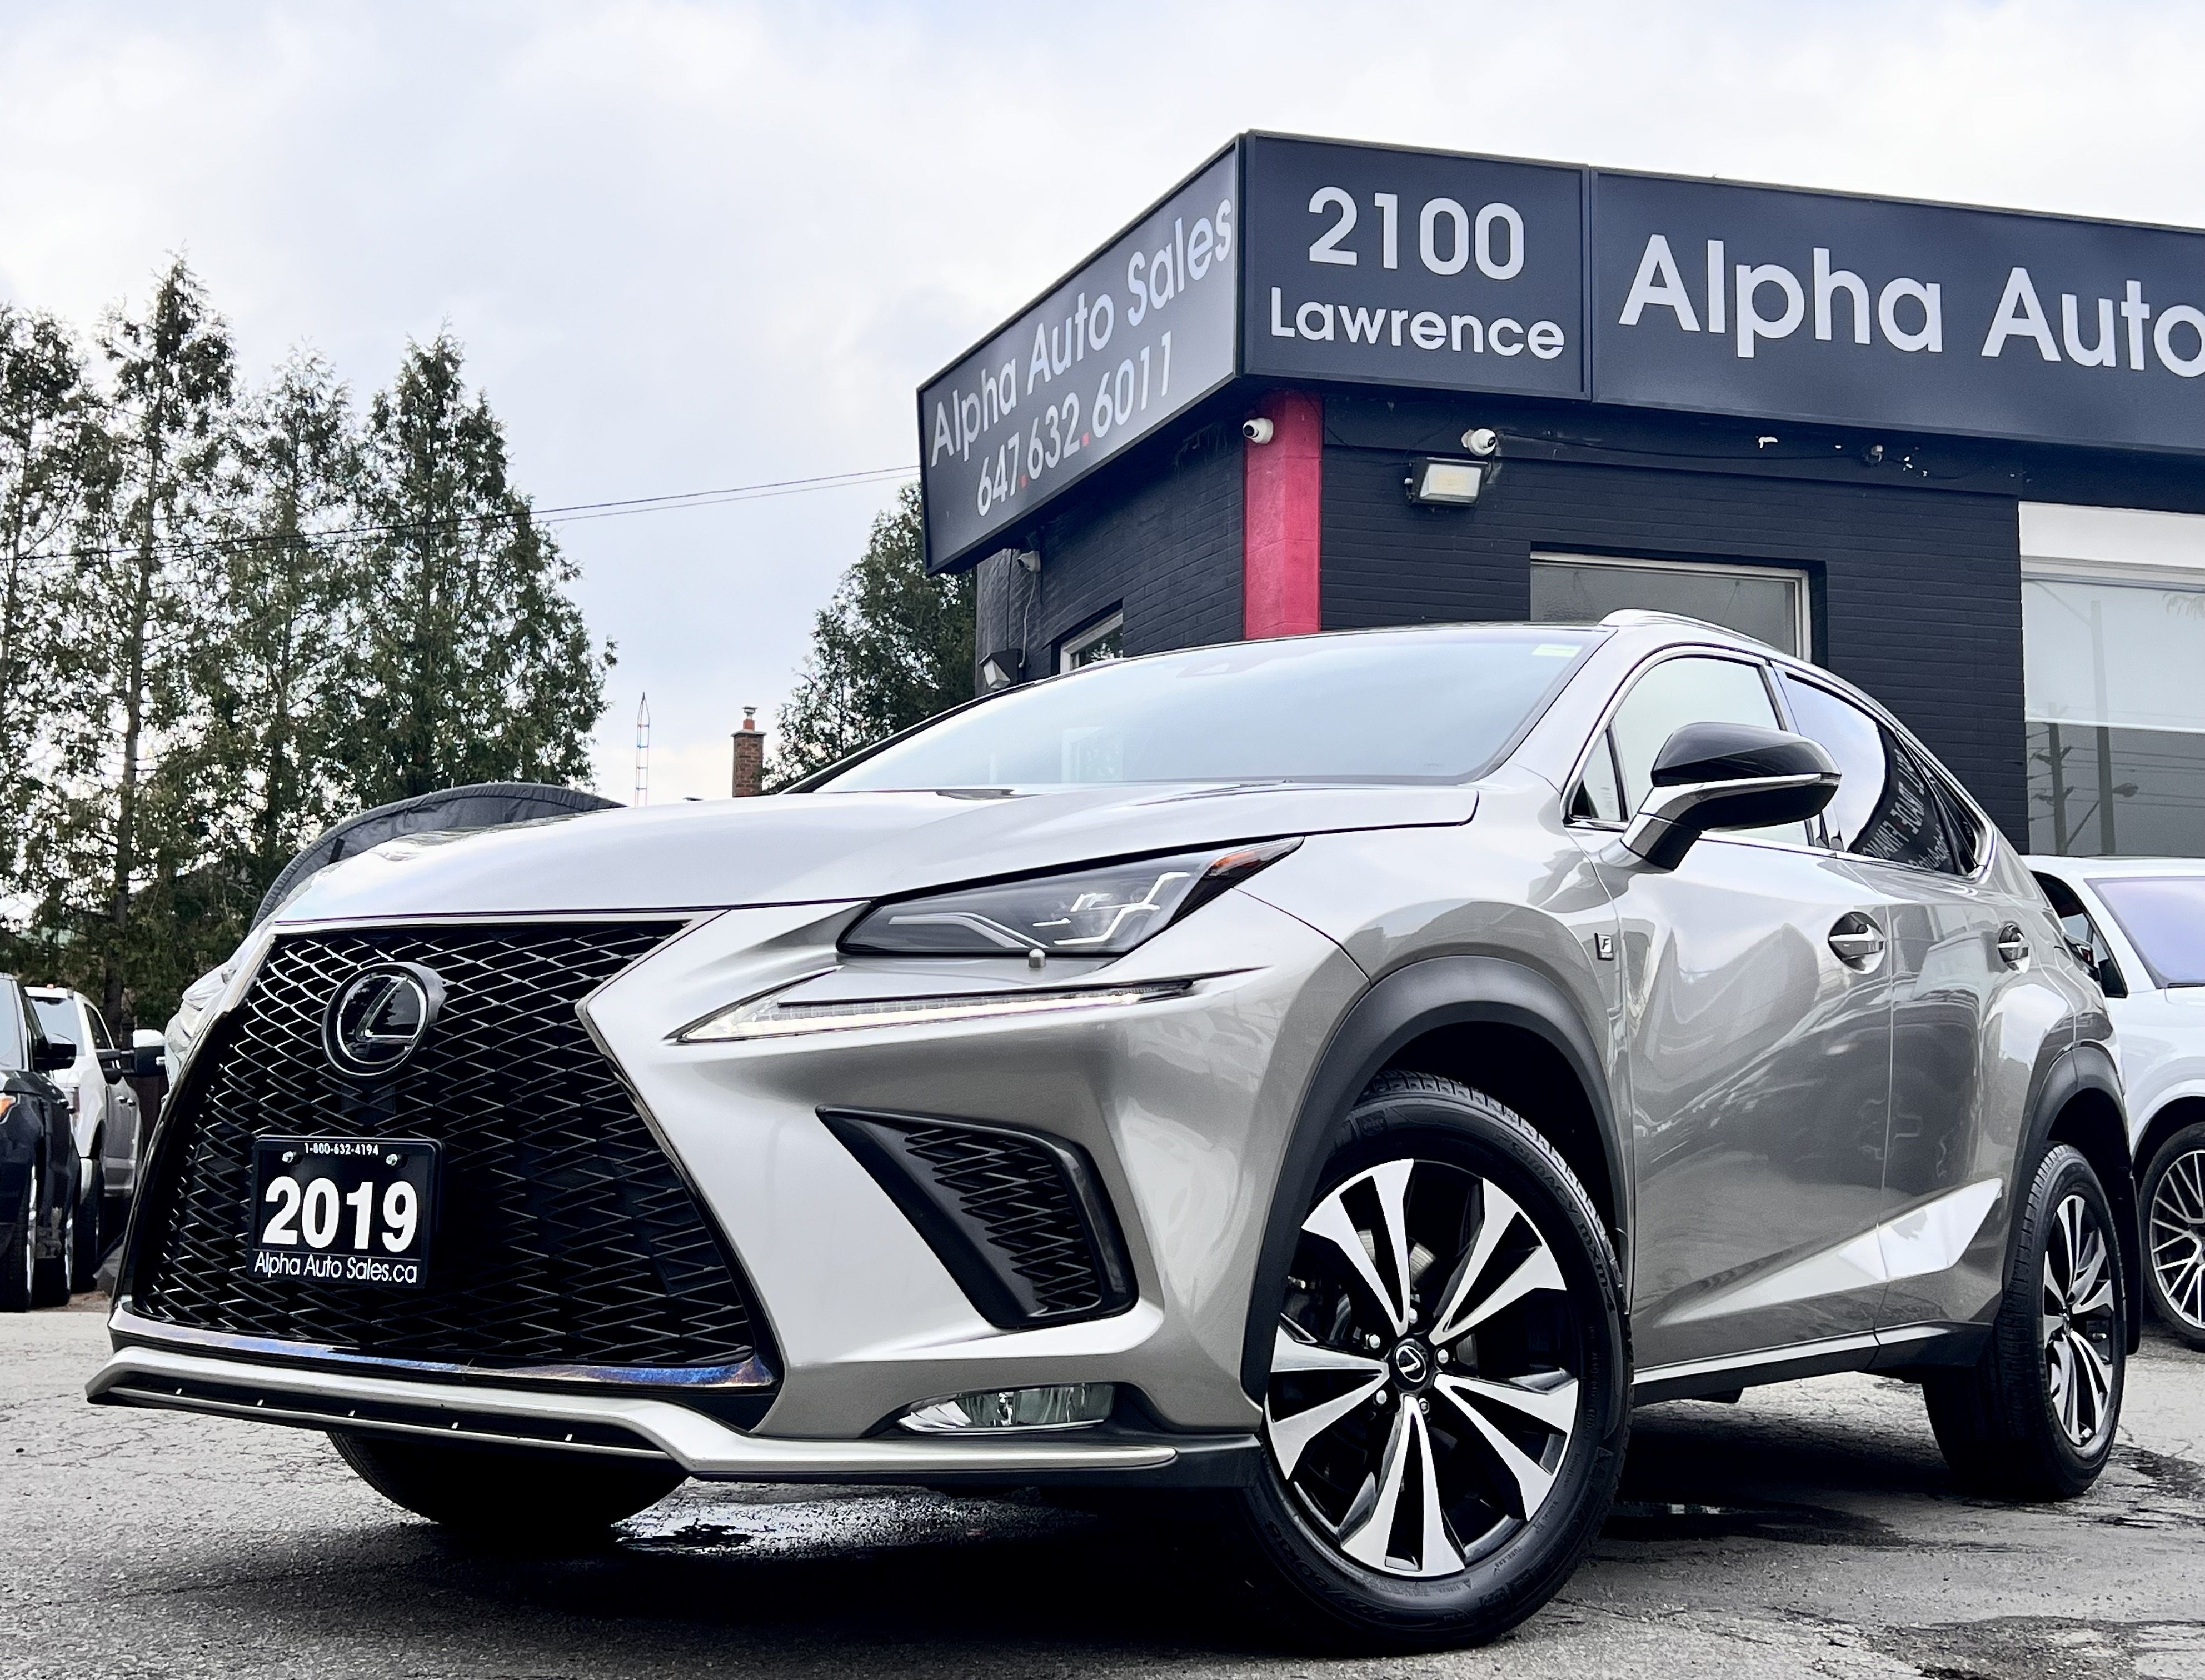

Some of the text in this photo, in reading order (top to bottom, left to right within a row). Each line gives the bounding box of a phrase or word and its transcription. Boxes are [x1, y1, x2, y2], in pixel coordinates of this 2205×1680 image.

[1308, 186, 1525, 280] 2100
[930, 198, 1233, 467] Alpha Auto Sales
[1270, 287, 1565, 359] Lawrence
[1618, 234, 2205, 377] Alpha Auto
[976, 330, 1172, 516] 647.632.6011
[305, 1143, 378, 1156] 1-800-632-4194
[262, 1176, 418, 1252] 2019
[254, 1251, 418, 1284] Alpha Auto Sales.ca
